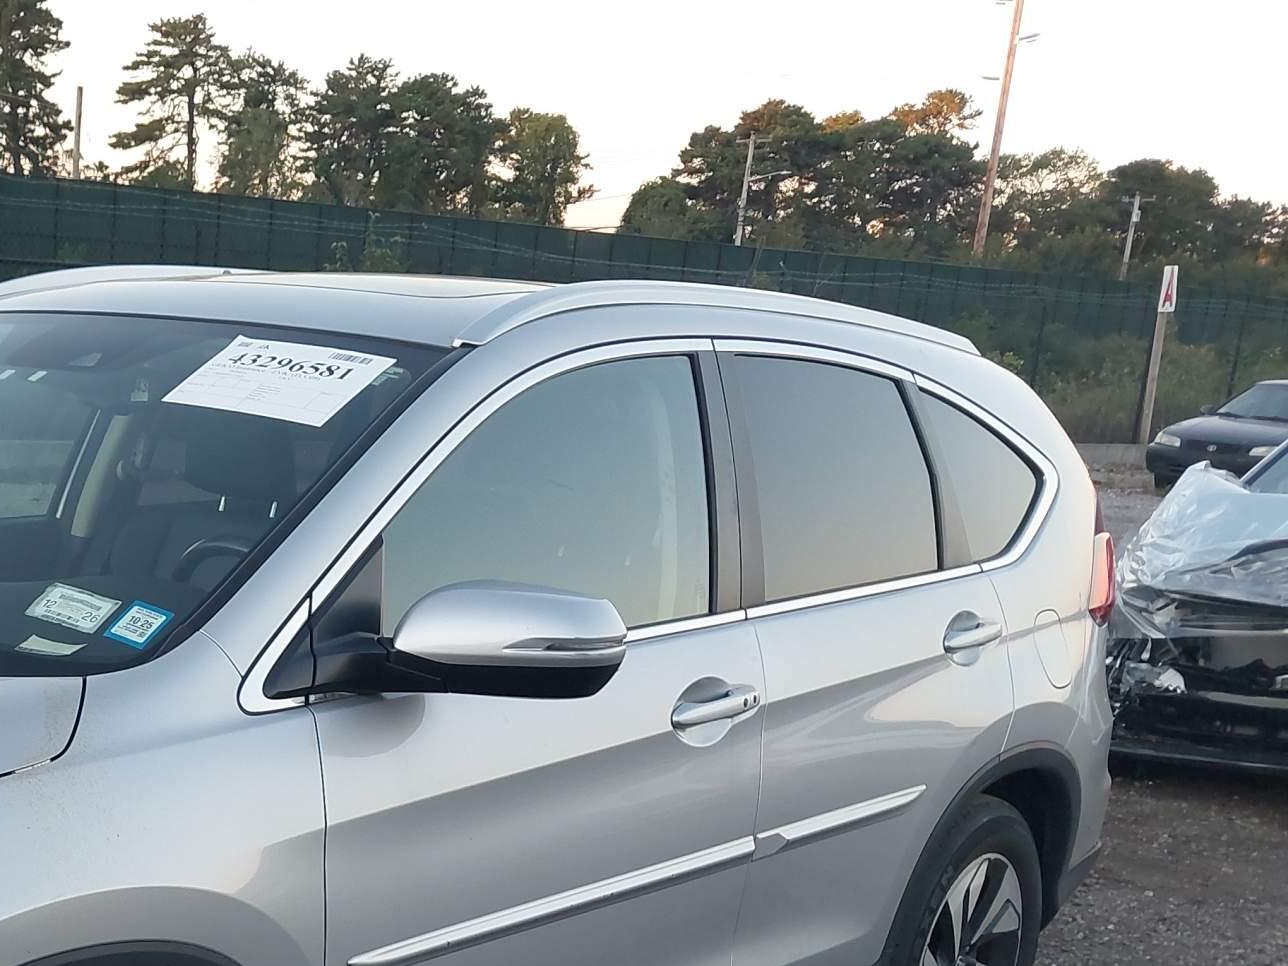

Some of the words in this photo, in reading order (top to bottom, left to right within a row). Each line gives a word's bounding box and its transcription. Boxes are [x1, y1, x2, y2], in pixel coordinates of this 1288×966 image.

[1162, 266, 1174, 308] A
[228, 353, 355, 381] 43296581
[42, 599, 57, 609] 12
[81, 611, 101, 623] 26
